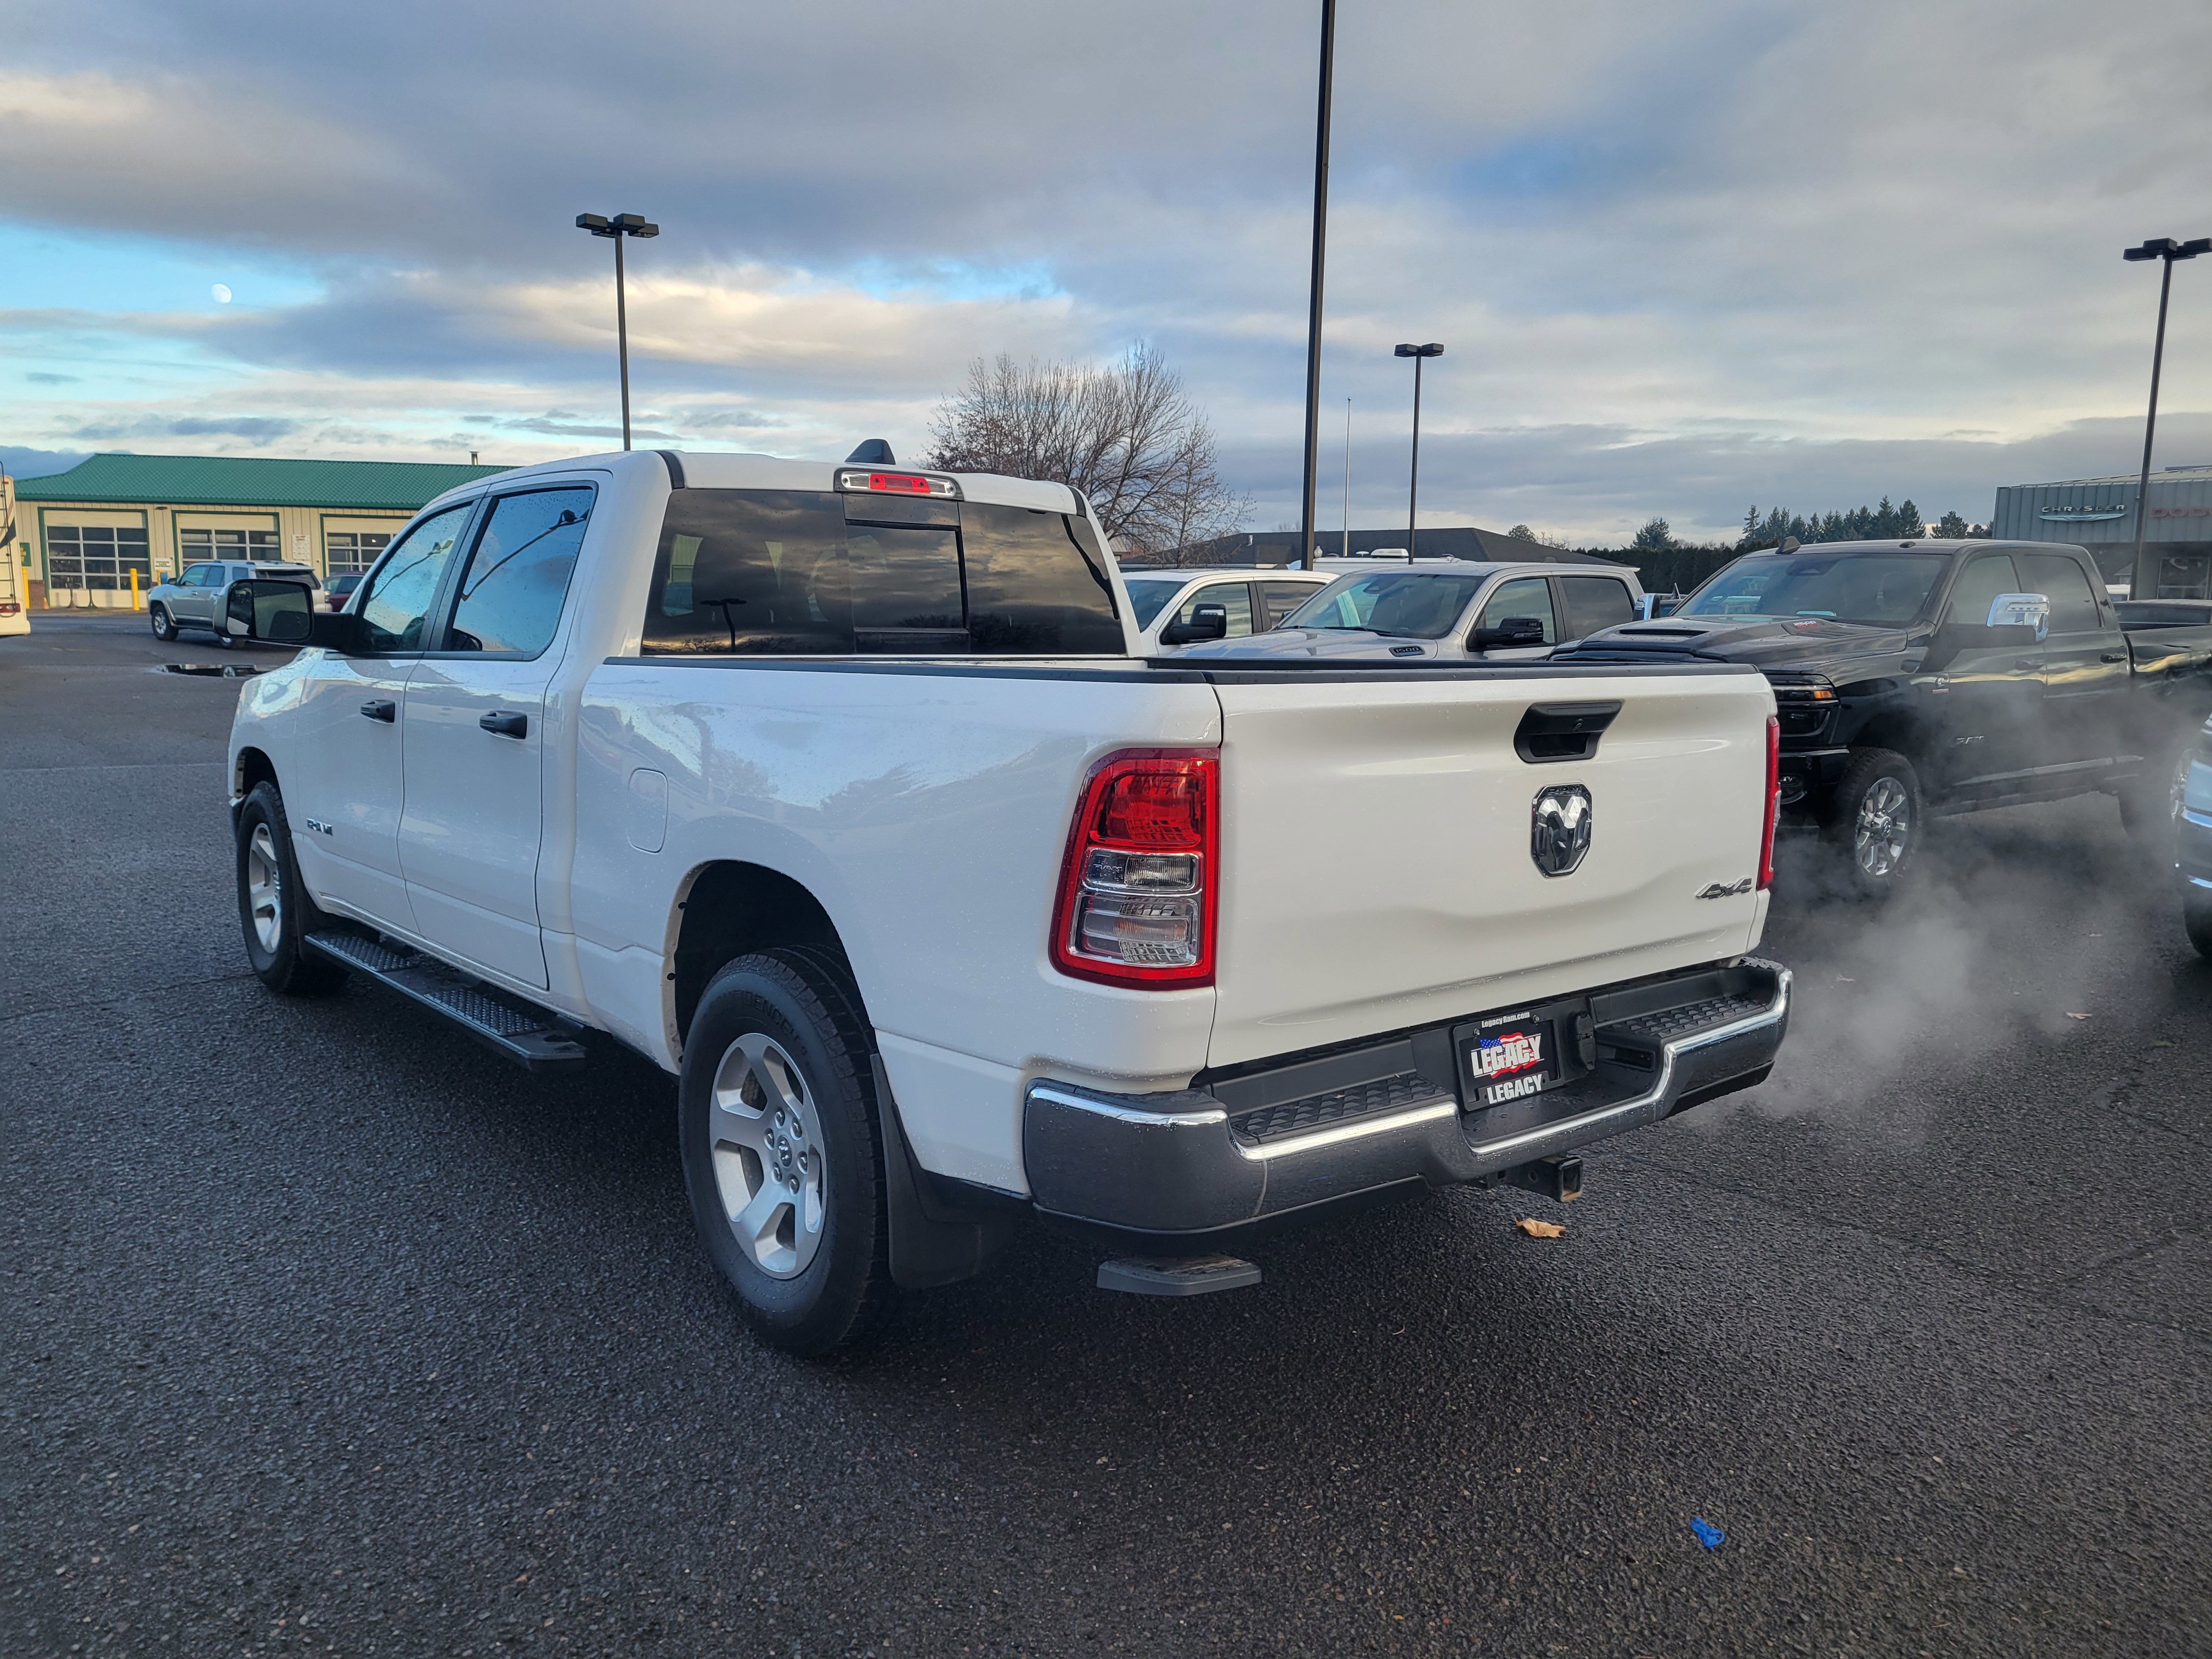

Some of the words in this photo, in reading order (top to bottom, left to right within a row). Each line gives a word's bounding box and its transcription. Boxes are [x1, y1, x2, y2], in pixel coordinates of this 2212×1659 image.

[2041, 504, 2125, 513] CHRYSLER
[2150, 506, 2212, 517] DOD
[1471, 1035, 1542, 1077] LEGACY
[1486, 1074, 1543, 1104] LEGACY
